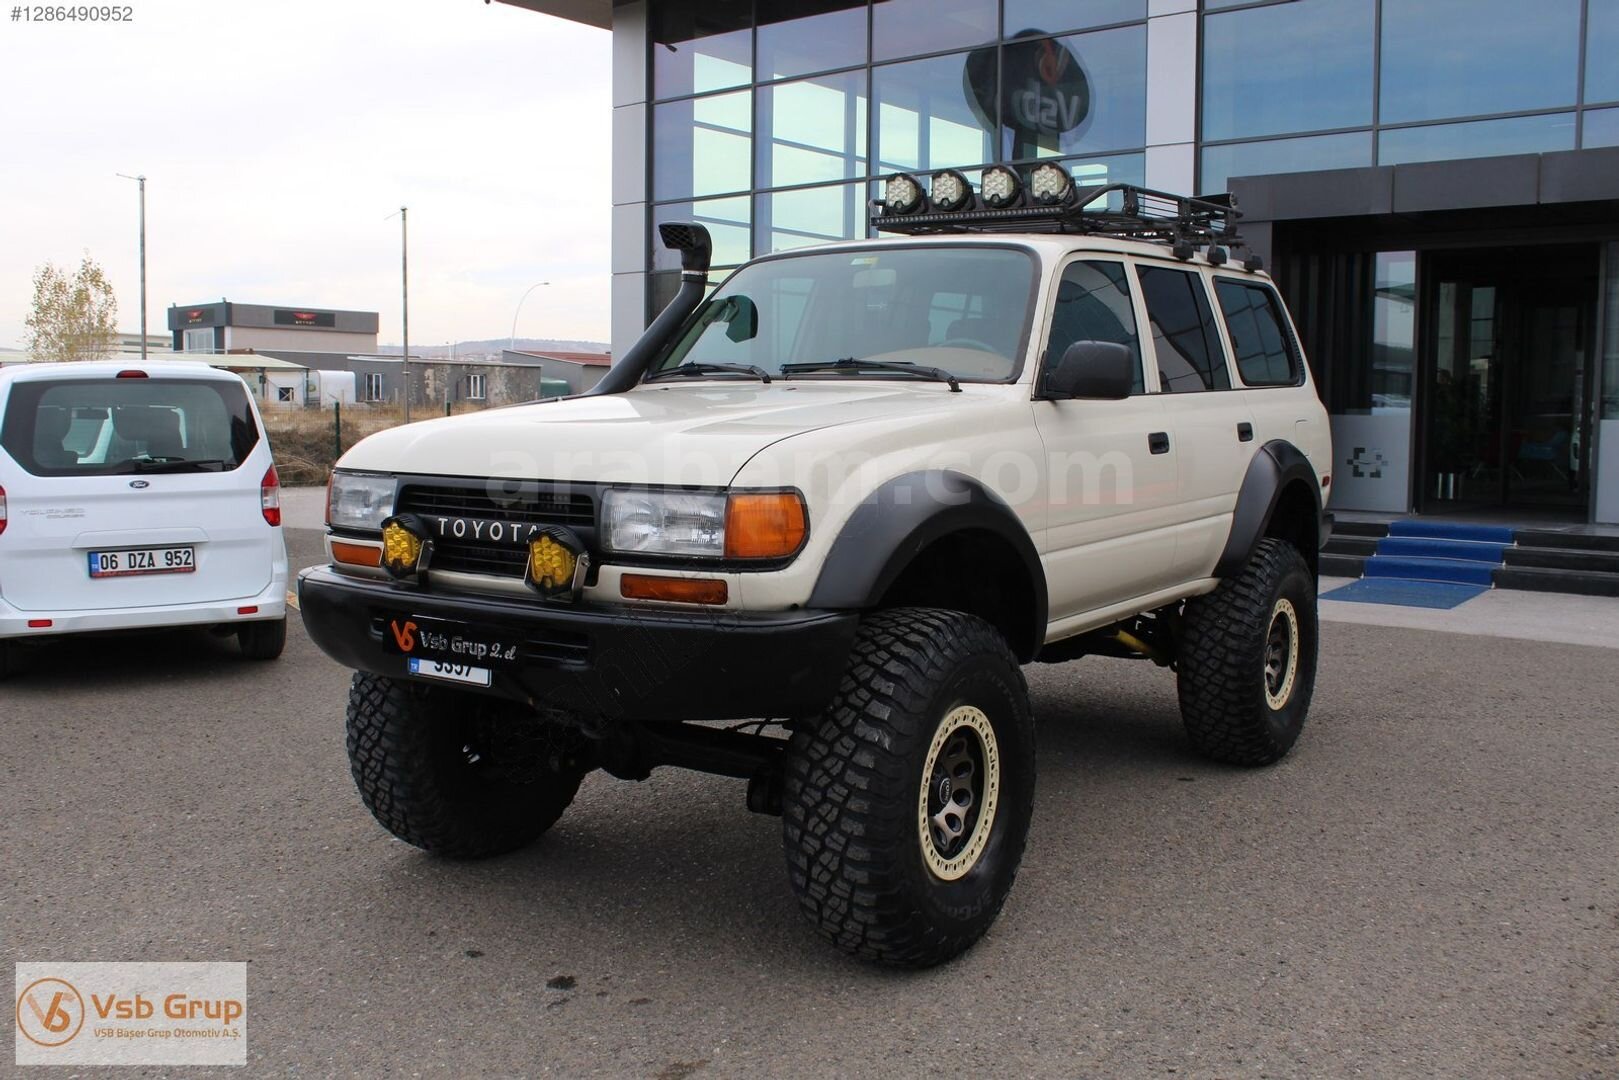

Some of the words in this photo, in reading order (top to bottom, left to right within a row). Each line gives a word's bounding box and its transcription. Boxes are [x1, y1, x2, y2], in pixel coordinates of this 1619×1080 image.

[100, 554, 119, 570] 06
[128, 552, 156, 569] DZA
[165, 550, 192, 566] 952
[420, 631, 448, 649] Vsb
[451, 636, 488, 660] Grup
